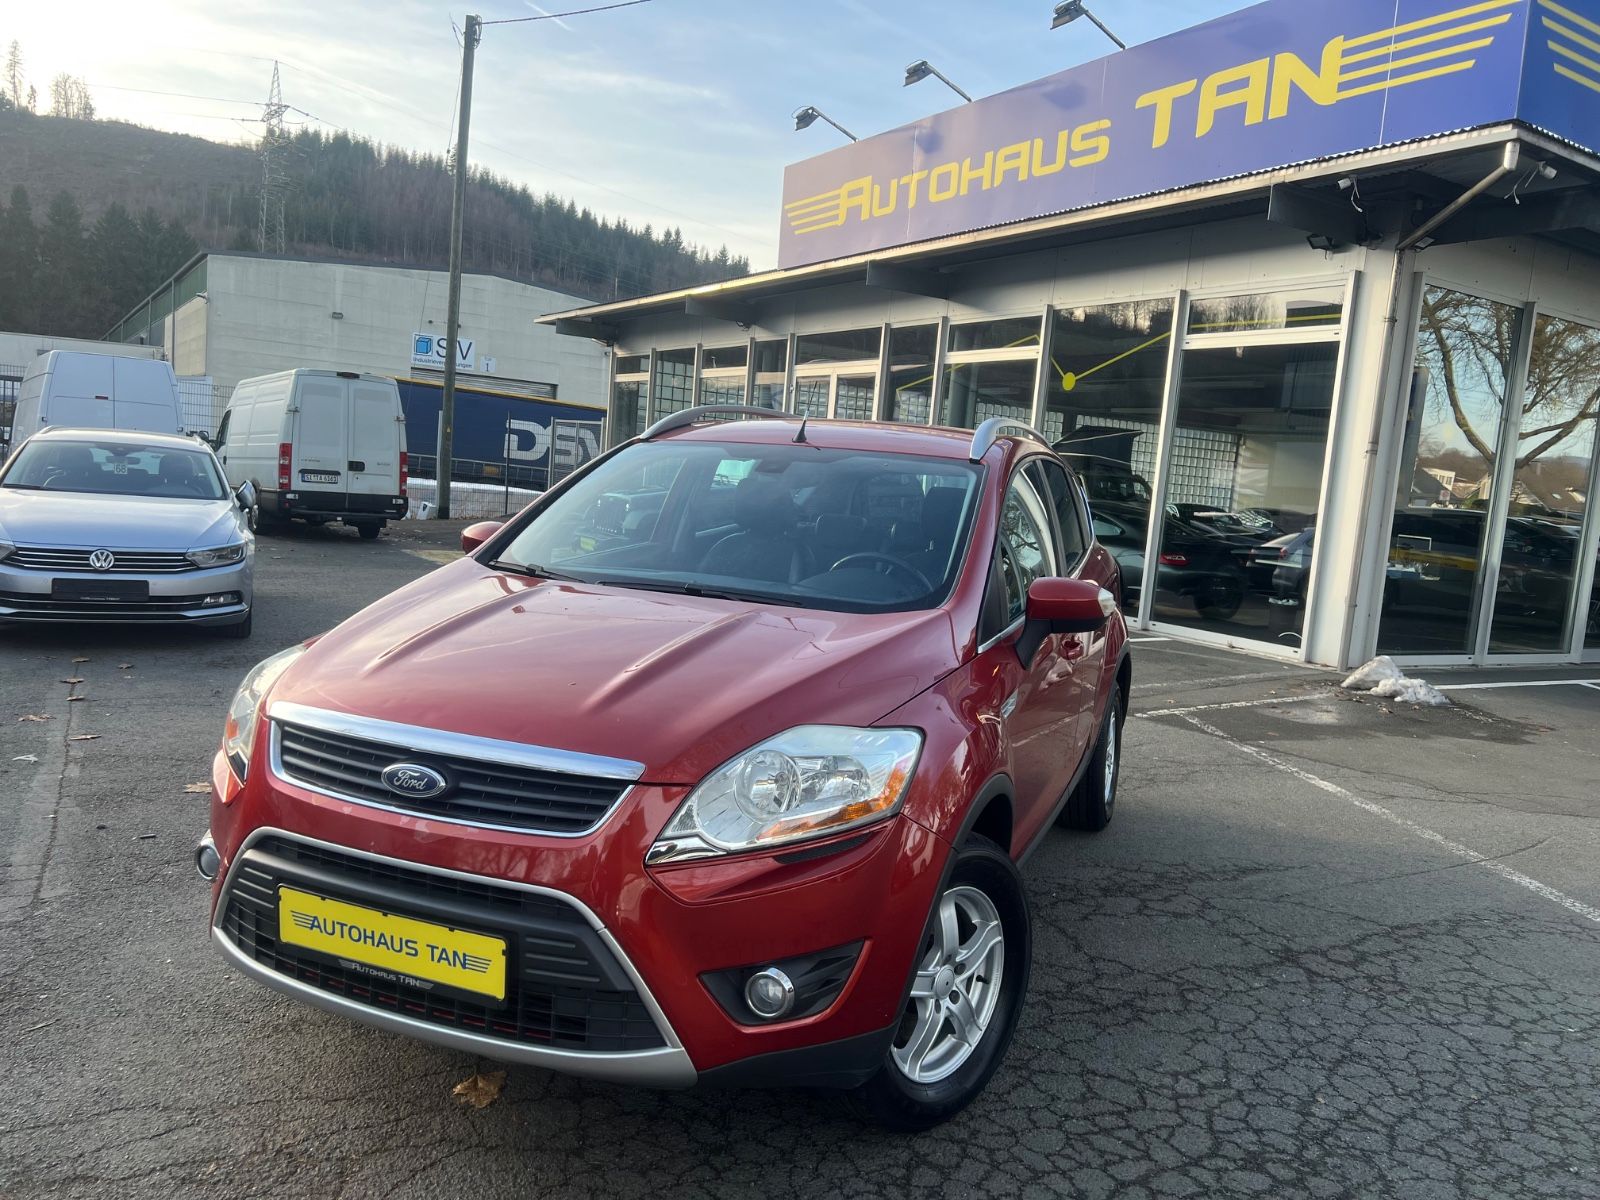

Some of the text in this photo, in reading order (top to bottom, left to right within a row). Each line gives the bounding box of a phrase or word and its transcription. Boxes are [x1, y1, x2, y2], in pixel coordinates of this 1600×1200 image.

[838, 35, 1344, 226] AUTOHAUS TAN
[436, 337, 472, 360] SV
[90, 549, 114, 570] VW
[393, 769, 428, 789] Ford
[310, 915, 467, 970] AUTOHAUS TAN
[352, 962, 420, 988] AUTOHAUS TAN
